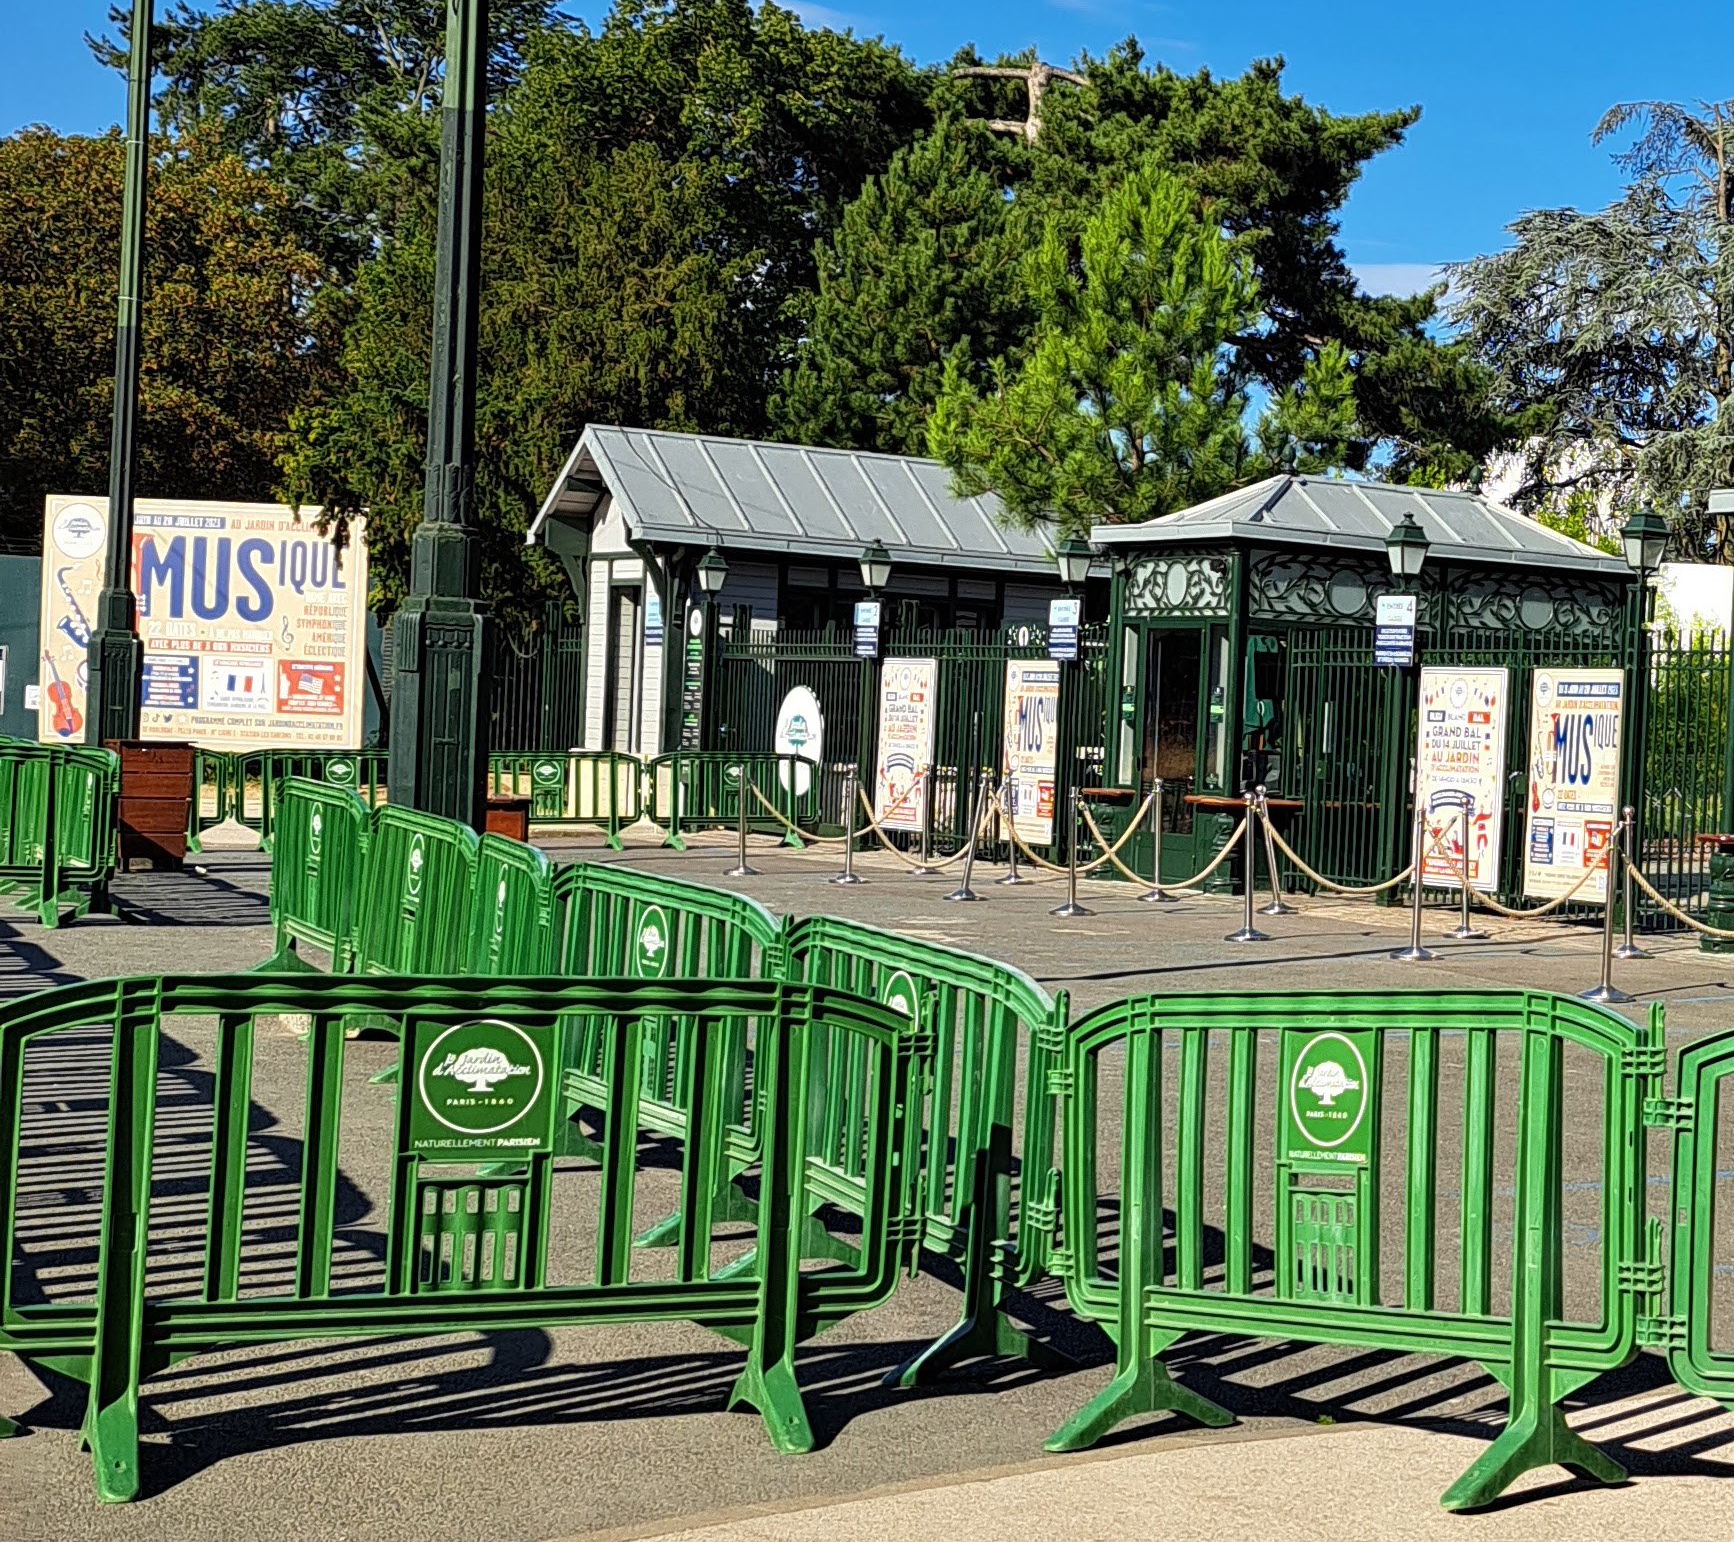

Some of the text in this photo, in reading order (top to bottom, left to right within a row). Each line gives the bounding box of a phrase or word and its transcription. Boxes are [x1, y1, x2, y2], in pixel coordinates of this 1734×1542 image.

[175, 516, 203, 527] JUILLET
[244, 519, 275, 531] JARDIN
[1406, 599, 1413, 613] 4
[171, 639, 191, 649] PLUS
[1432, 725, 1482, 739] GRAND BAL
[1553, 713, 1619, 785] MUSIQUE
[1432, 751, 1480, 765] AU JARDIN
[462, 1051, 502, 1065] Jardin
[432, 1062, 532, 1077] d'Acclimatation
[446, 1097, 476, 1105] PARIS
[414, 1137, 540, 1148] NATURELLEMENT PARISIEN
